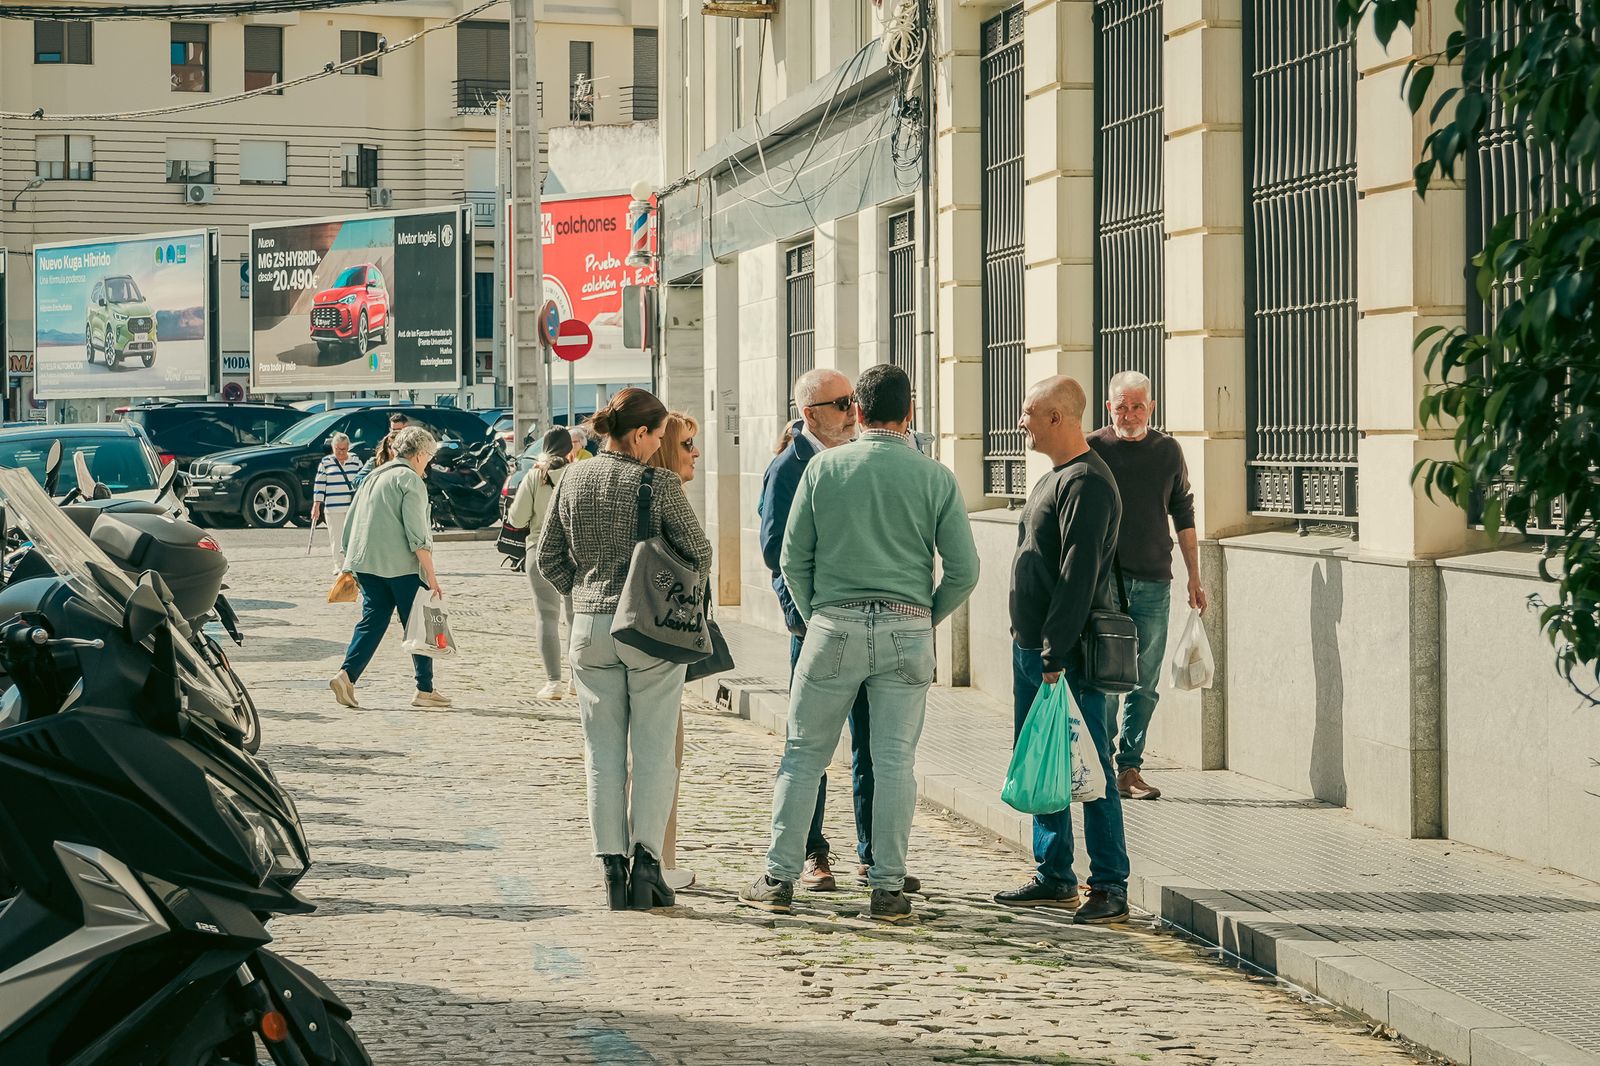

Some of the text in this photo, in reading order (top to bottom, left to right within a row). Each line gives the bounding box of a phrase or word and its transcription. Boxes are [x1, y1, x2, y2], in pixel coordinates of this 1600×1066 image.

[556, 214, 617, 235] colchones
[258, 238, 275, 248] Nuevo
[398, 232, 416, 245] Motor
[418, 230, 436, 246] Inglés
[40, 256, 62, 271] Nuevo
[64, 255, 82, 272] Kuga
[258, 249, 322, 269] MG ZS HYBRID+
[584, 252, 621, 272] Prueba
[258, 272, 273, 283] desde
[581, 274, 618, 294] colchón
[620, 270, 631, 288] de
[223, 356, 250, 369] MODA
[258, 361, 296, 373] Para todo y más
[195, 922, 220, 933] 125
